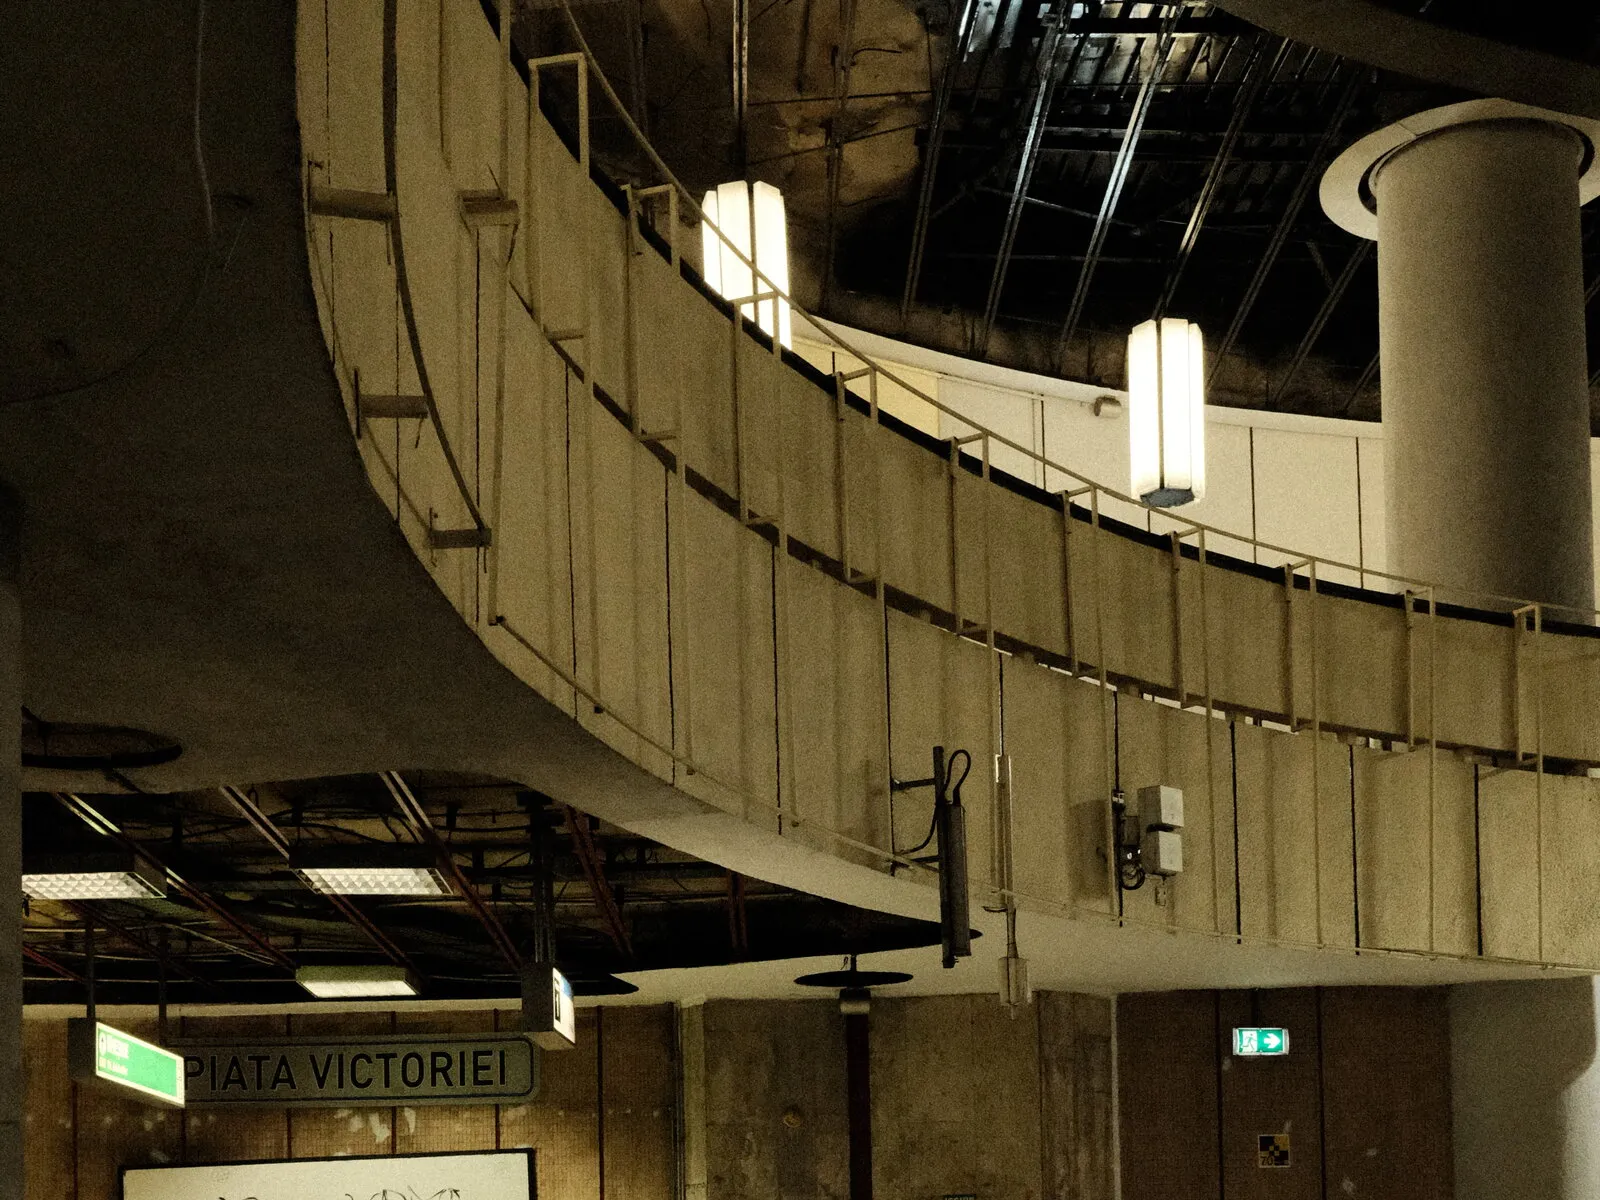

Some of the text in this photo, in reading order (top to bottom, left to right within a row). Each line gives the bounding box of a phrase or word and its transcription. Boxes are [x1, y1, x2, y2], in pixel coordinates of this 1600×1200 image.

[184, 1049, 506, 1090] PIATA VICTORIEI
[1260, 1155, 1274, 1166] 70
